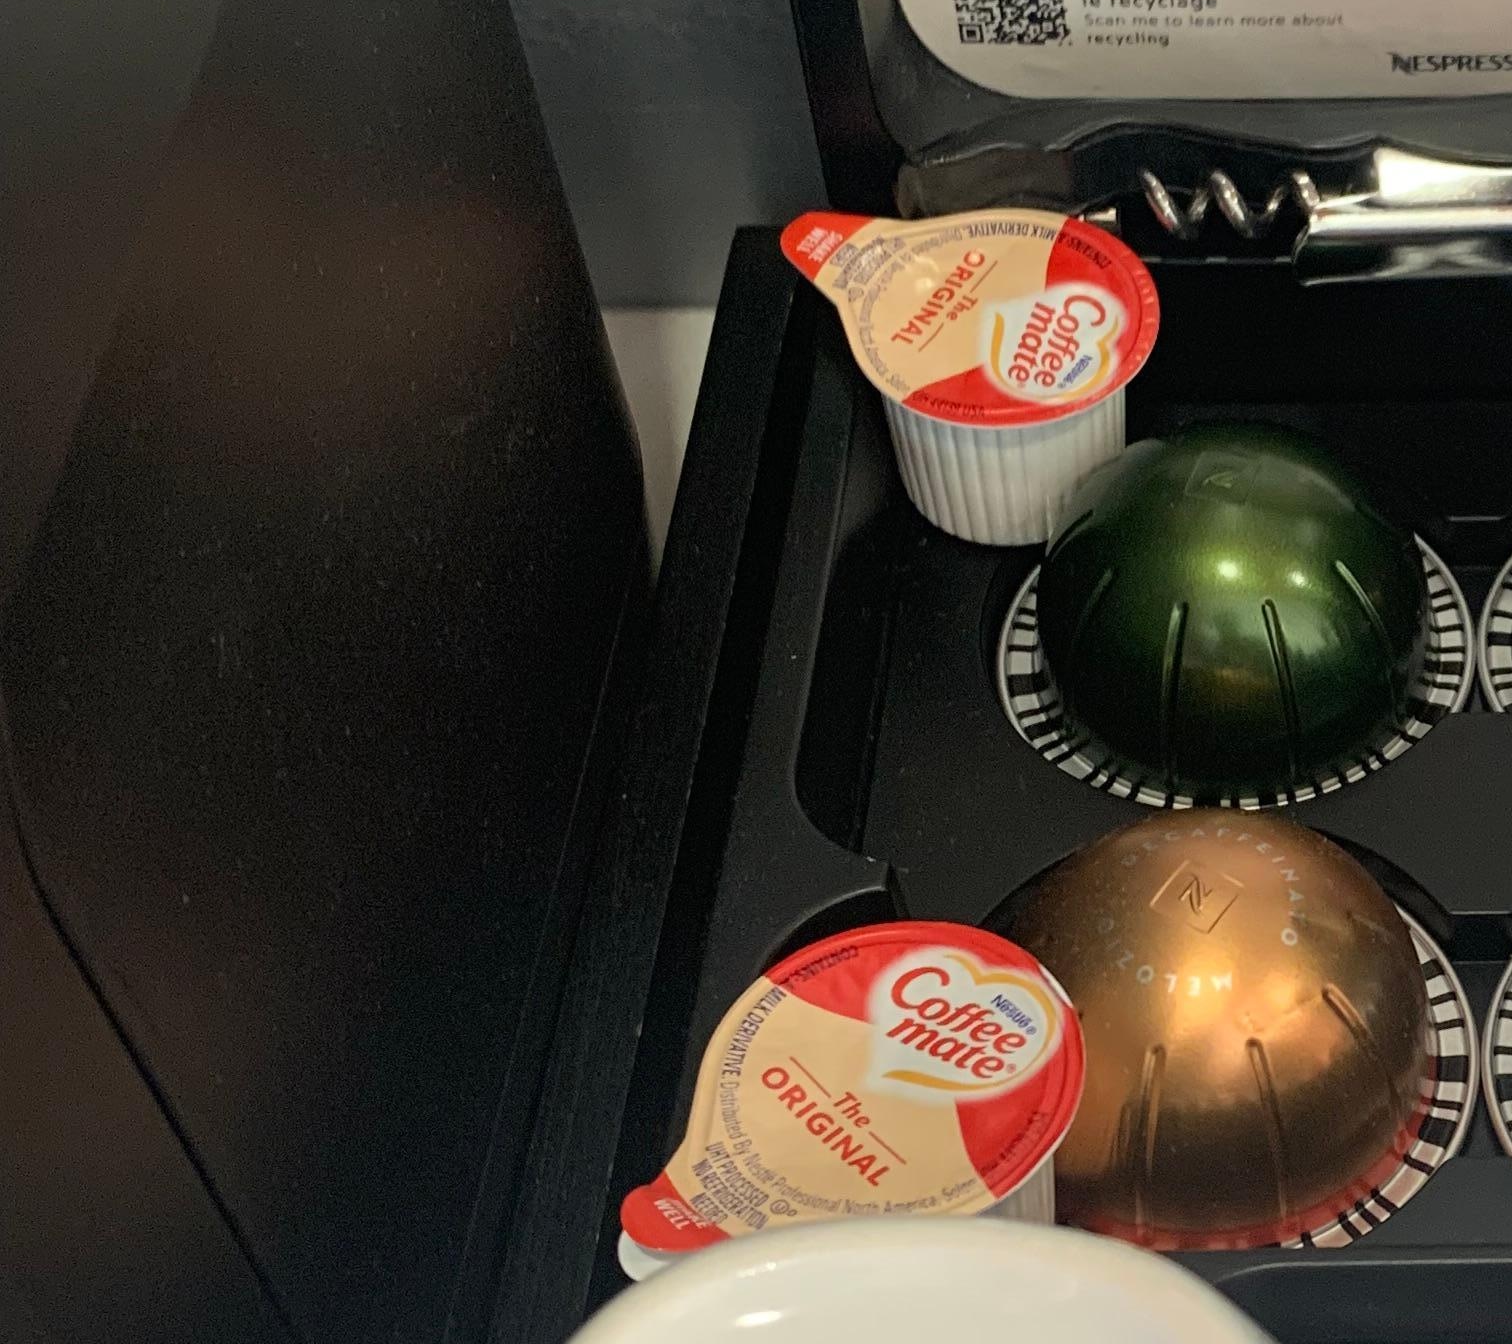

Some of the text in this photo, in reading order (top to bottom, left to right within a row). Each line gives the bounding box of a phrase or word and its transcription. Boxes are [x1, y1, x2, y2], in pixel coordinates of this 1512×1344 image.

[1084, 11, 1343, 27] Scan me to learn more about
[1088, 31, 1169, 49] recycling
[890, 250, 986, 345] ORIGINAL
[947, 288, 978, 321] The
[1008, 301, 1056, 386] mate
[1034, 293, 1107, 389] Coffee
[751, 986, 787, 1018] MILK
[890, 966, 1026, 1054] Coffee
[885, 1019, 1005, 1079] mate
[720, 1081, 741, 1140] Distributed
[761, 1066, 891, 1187] ORIGINAL
[833, 1091, 872, 1129] The
[717, 1155, 770, 1208] PROCESSED
[772, 1176, 842, 1213] Professional
[654, 1199, 690, 1230] WELL
